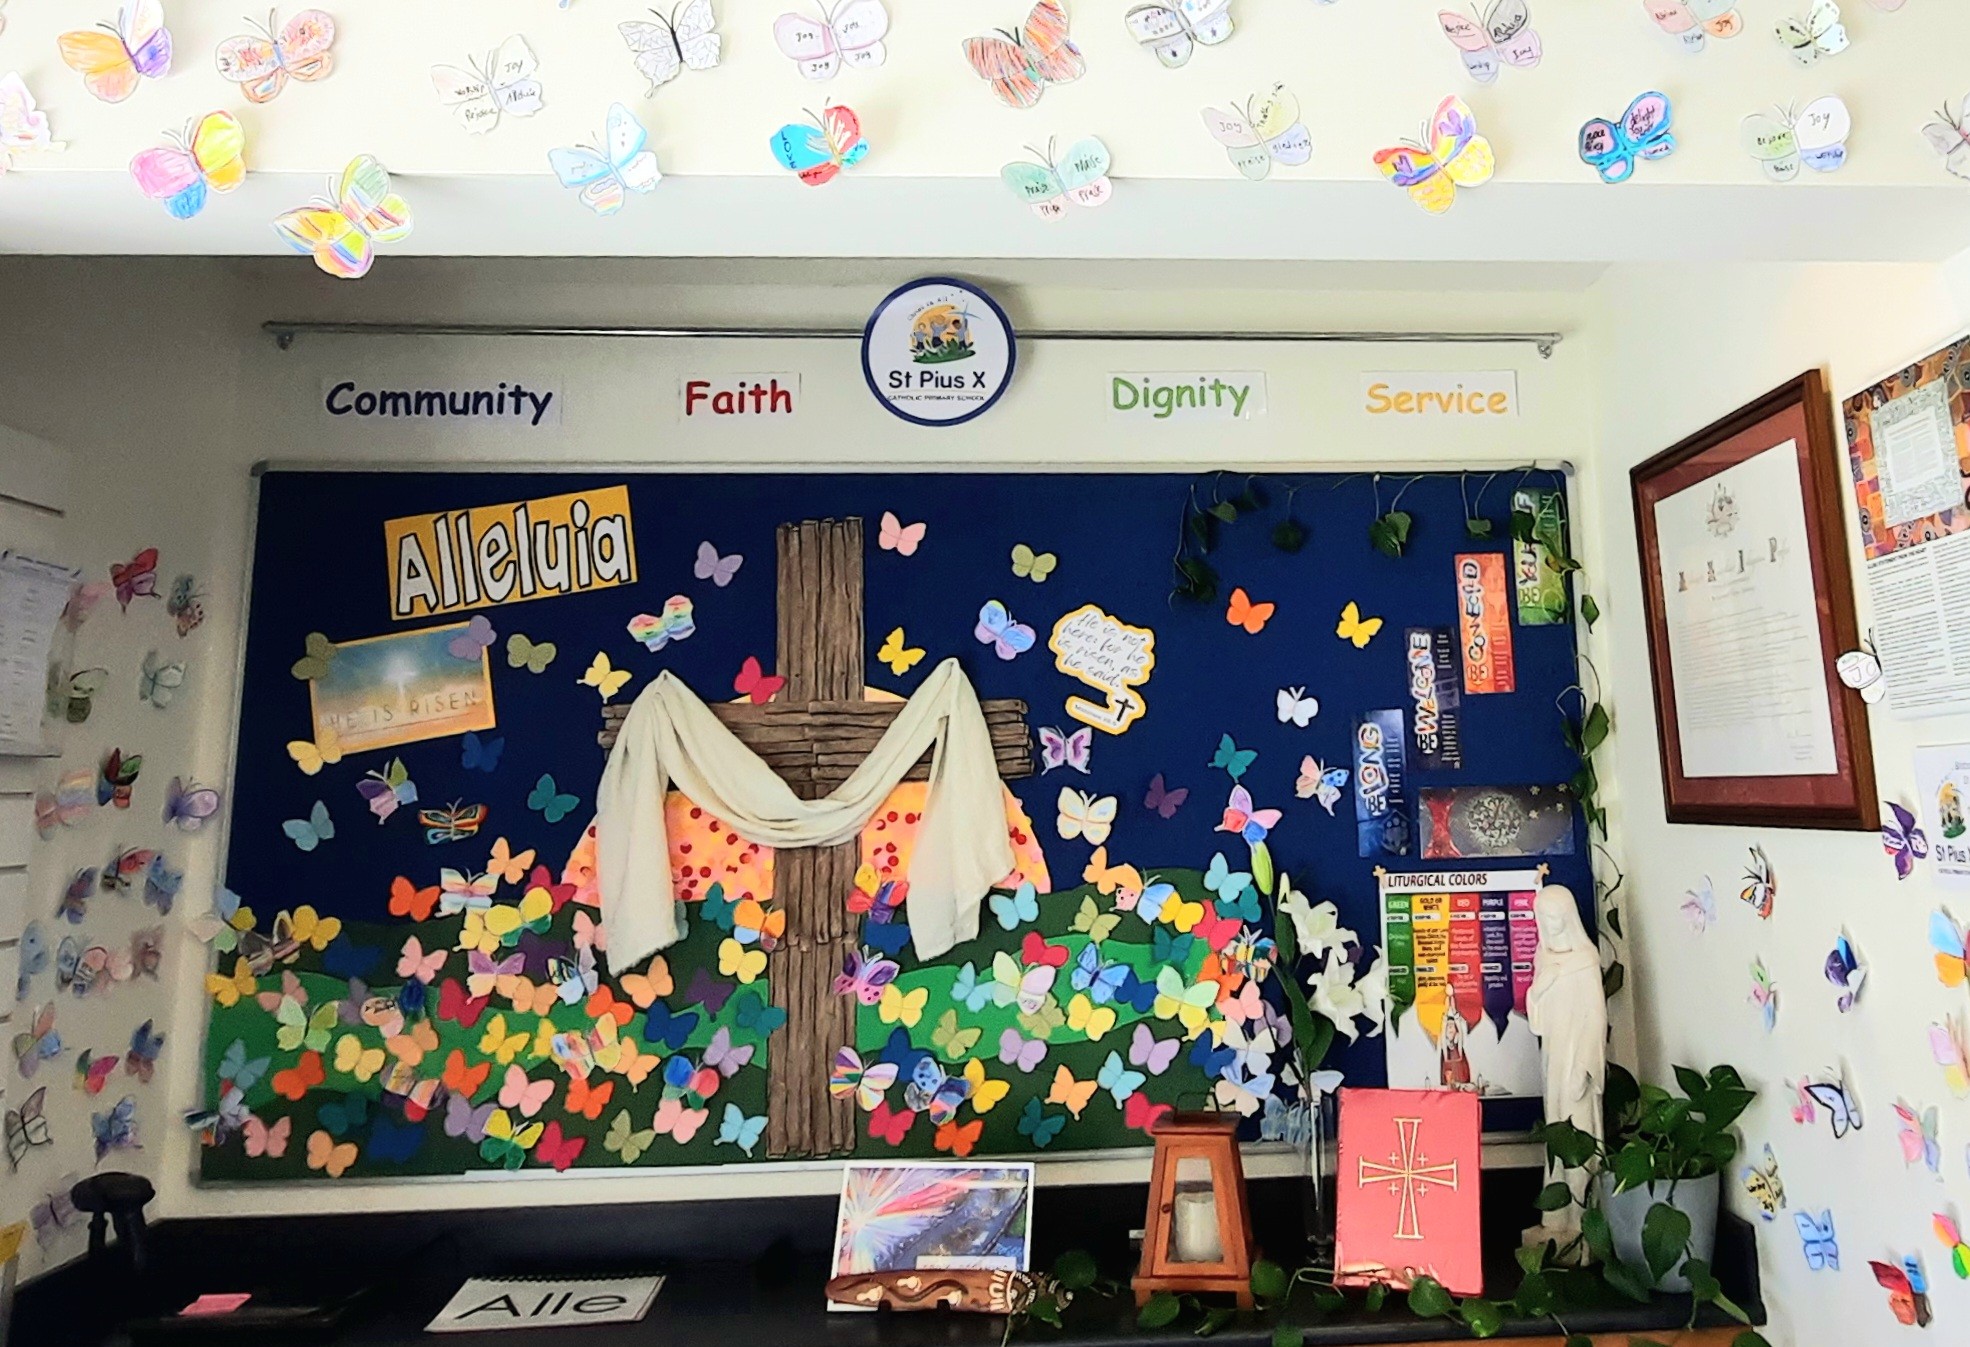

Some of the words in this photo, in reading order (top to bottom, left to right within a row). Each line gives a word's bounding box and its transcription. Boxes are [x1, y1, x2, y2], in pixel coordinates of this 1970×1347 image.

[888, 370, 912, 389] St
[920, 370, 965, 389] Pius
[972, 371, 986, 389] X
[325, 381, 553, 426] Community
[684, 379, 793, 416] Faith
[1112, 376, 1250, 419] Dignity
[1365, 382, 1508, 415] Service
[395, 498, 632, 616] Alleluia
[1078, 613, 1098, 629] He
[1103, 624, 1117, 637] is
[1064, 654, 1082, 669] he
[1100, 638, 1122, 654] for
[1127, 647, 1146, 664] he
[372, 704, 394, 723] IS
[410, 690, 477, 716] RISEN
[1419, 734, 1437, 752] BE
[1368, 795, 1386, 813] BE
[1388, 874, 1446, 887] LITURGICAL
[1448, 873, 1488, 886] COLORS
[453, 1291, 628, 1320] Alle
